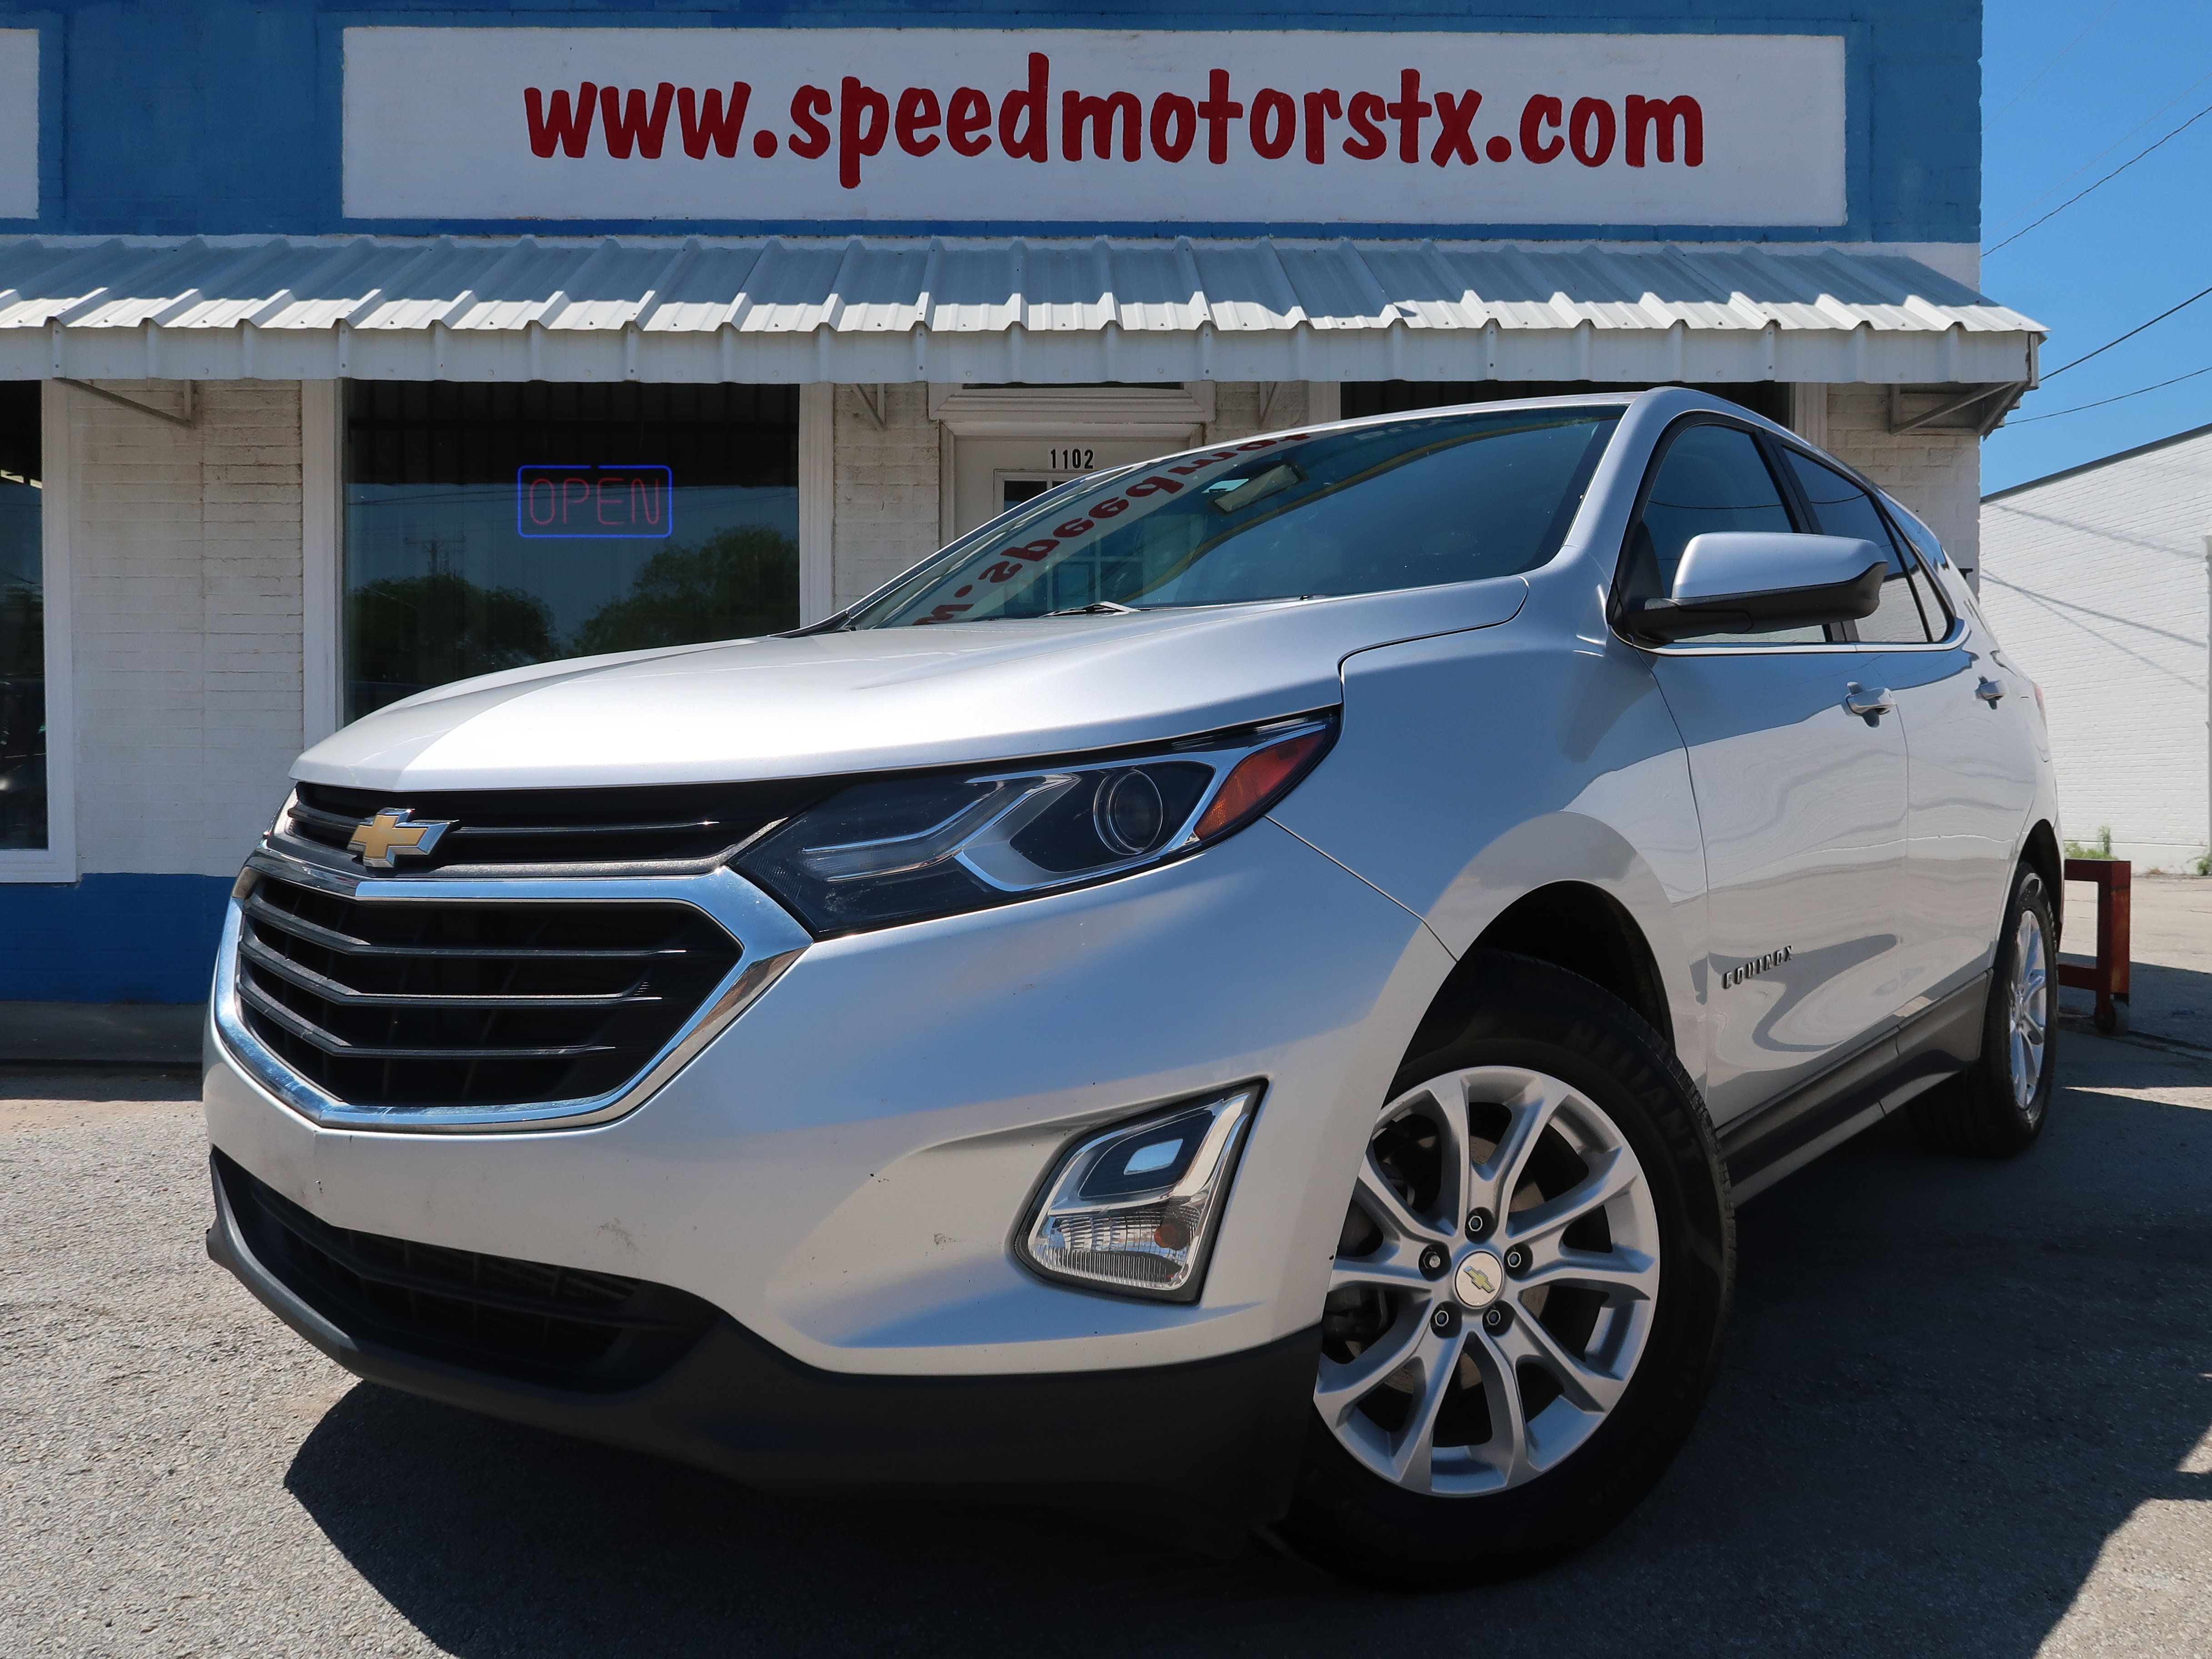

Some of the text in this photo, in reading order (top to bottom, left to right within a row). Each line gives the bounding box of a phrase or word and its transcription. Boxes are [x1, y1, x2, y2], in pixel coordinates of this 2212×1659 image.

[524, 52, 1703, 189] www.speedmotorstx.com
[1051, 448, 1093, 469] 1102
[529, 478, 659, 525] OPEN
[1722, 945, 1793, 989] EQUINOX
